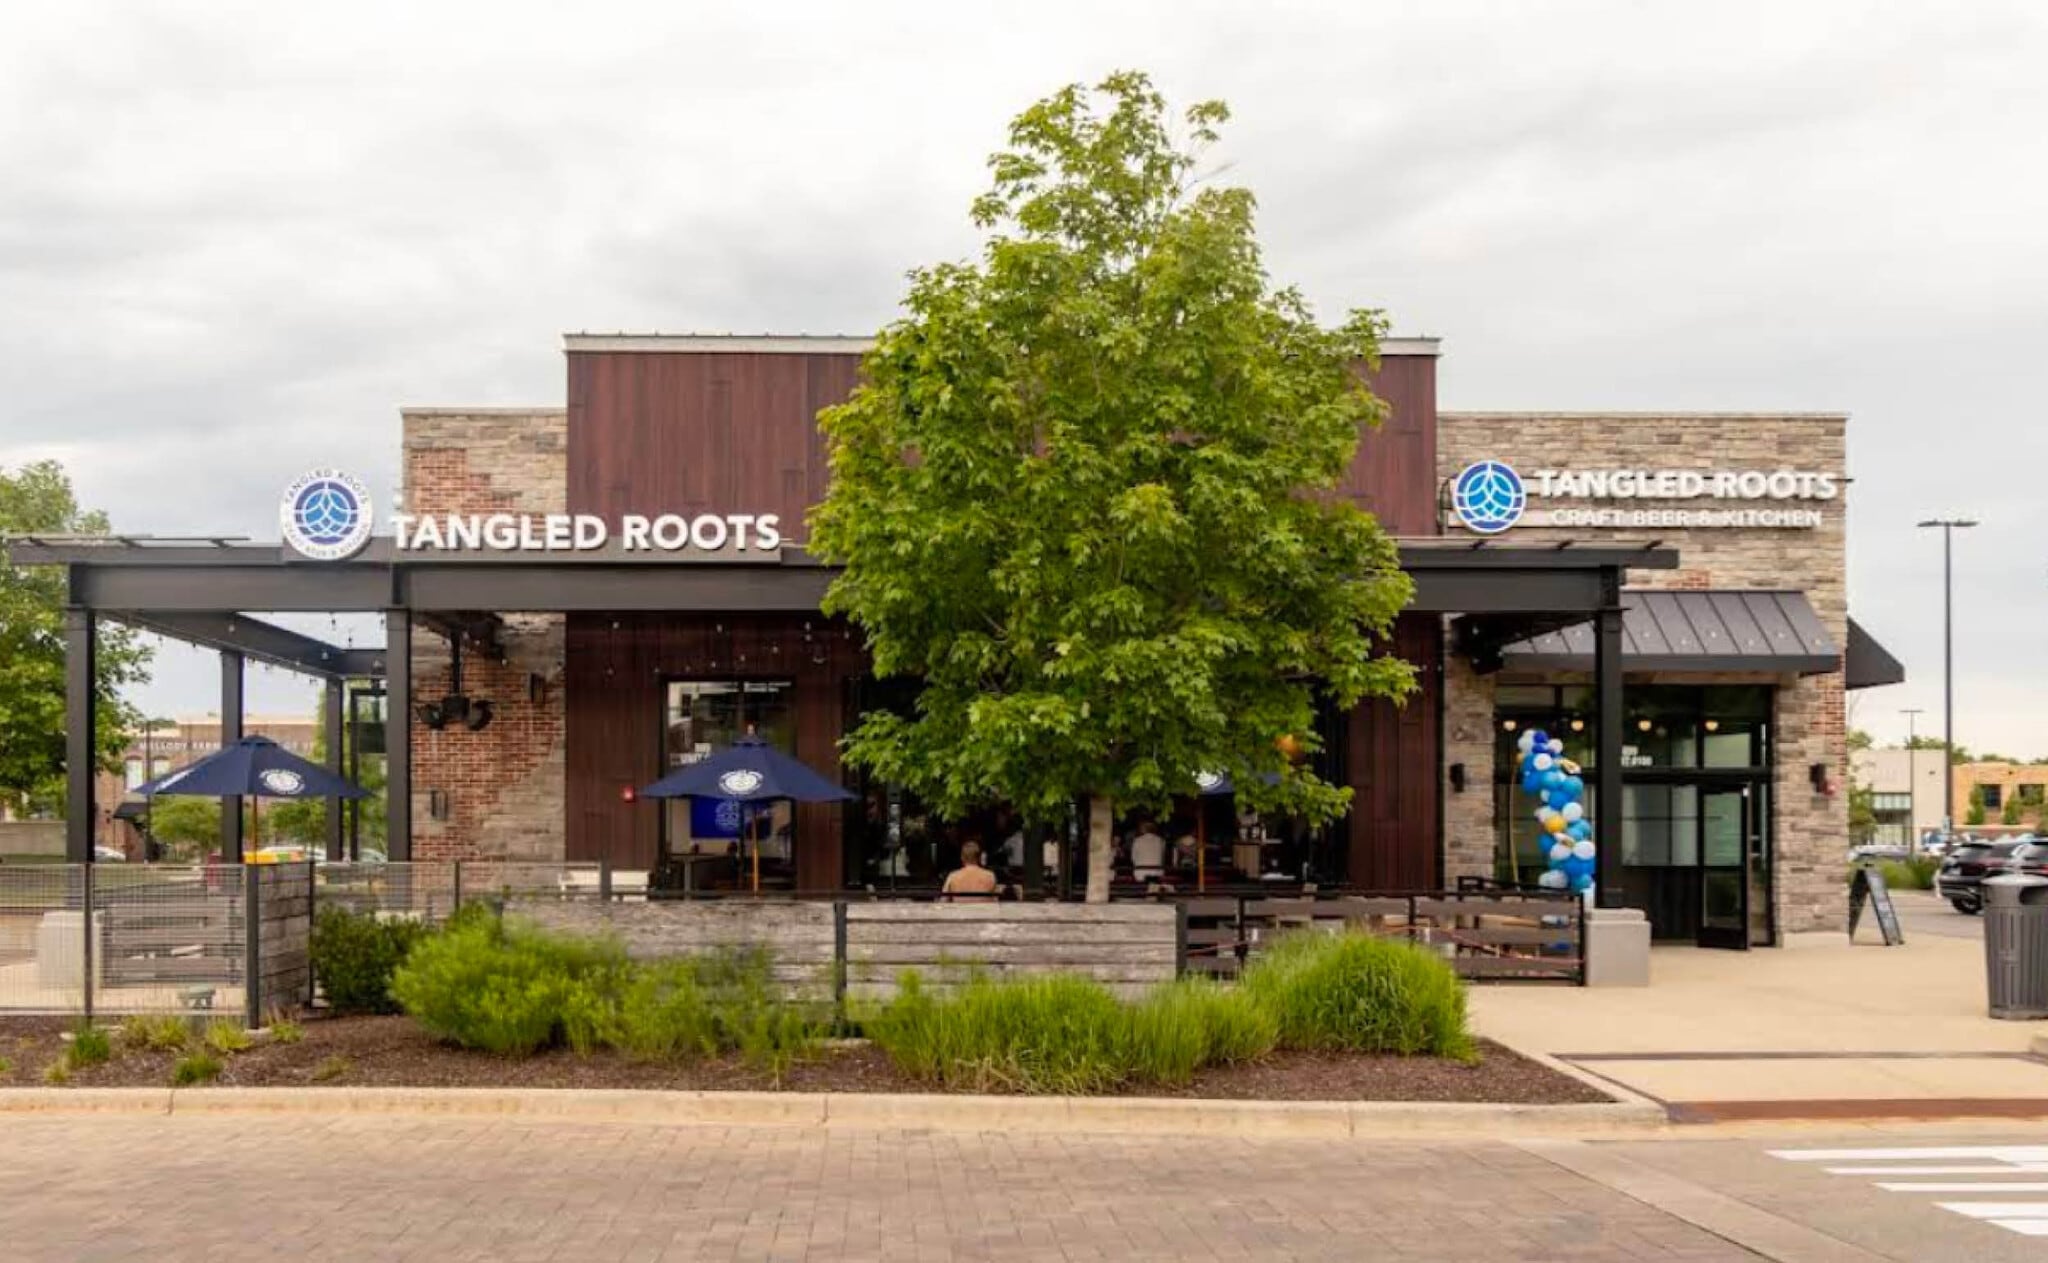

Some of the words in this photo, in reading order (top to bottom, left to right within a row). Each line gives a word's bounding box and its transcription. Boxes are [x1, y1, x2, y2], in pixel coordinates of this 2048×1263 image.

[1535, 470, 1704, 499] TANGLED
[1713, 471, 1838, 499] ROOTS
[389, 514, 607, 551] TANGLED
[622, 514, 781, 551] ROOTS
[1550, 509, 1625, 526] CRAFT
[1633, 509, 1688, 526] BEER
[1699, 509, 1711, 526] &
[1726, 509, 1823, 527] KITCHEN
